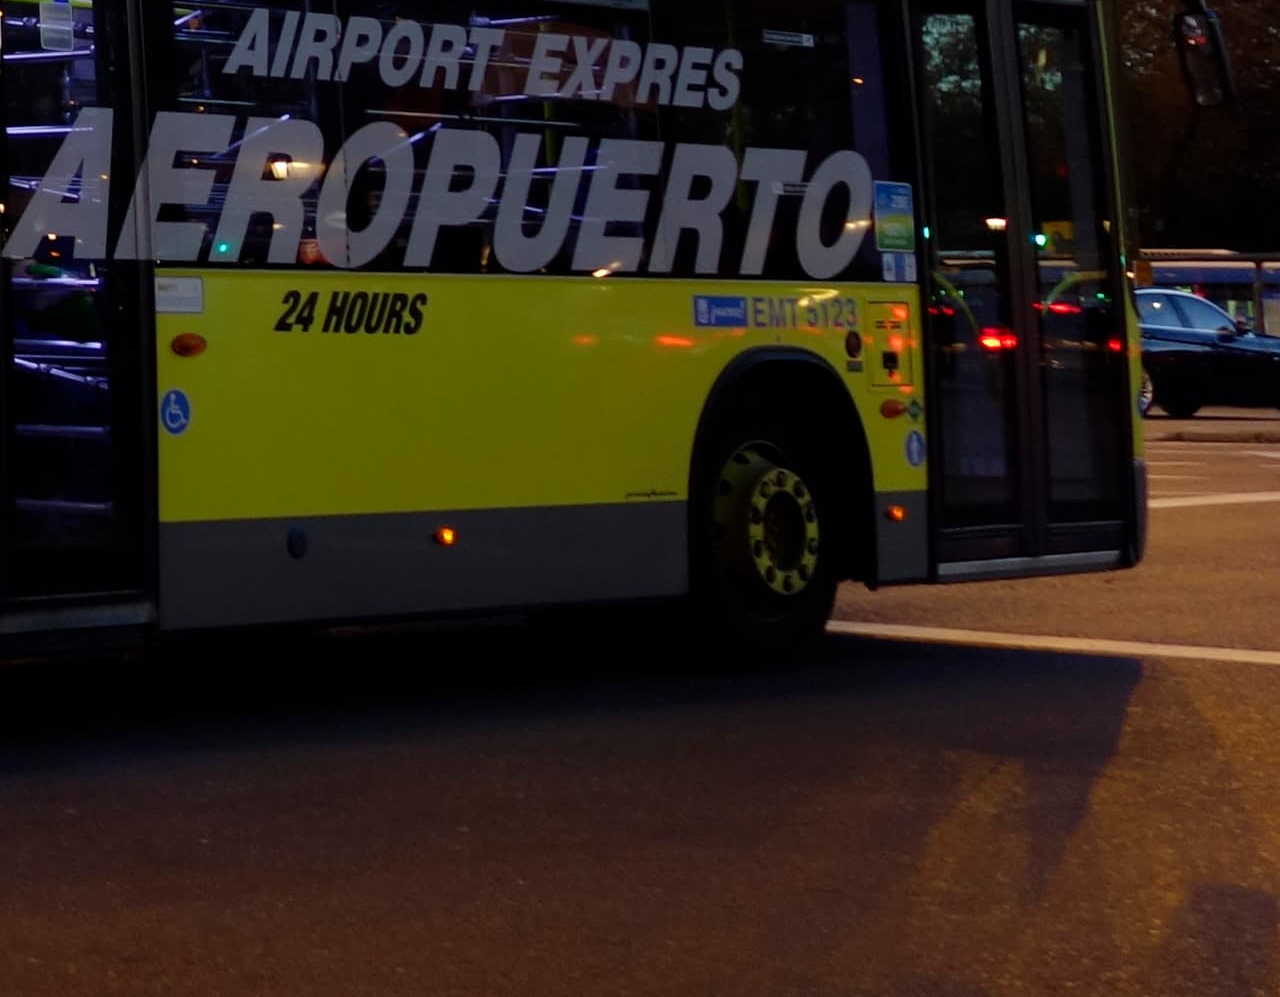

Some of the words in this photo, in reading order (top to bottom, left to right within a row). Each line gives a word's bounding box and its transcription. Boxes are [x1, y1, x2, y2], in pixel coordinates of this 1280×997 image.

[223, 6, 505, 92] AIRPORT
[524, 31, 744, 111] EXPRES
[0, 106, 874, 280] AEROPUERTO
[274, 290, 320, 333] 24
[322, 291, 428, 335] HOURS
[753, 297, 798, 328] EMT
[806, 298, 858, 328] 5123
